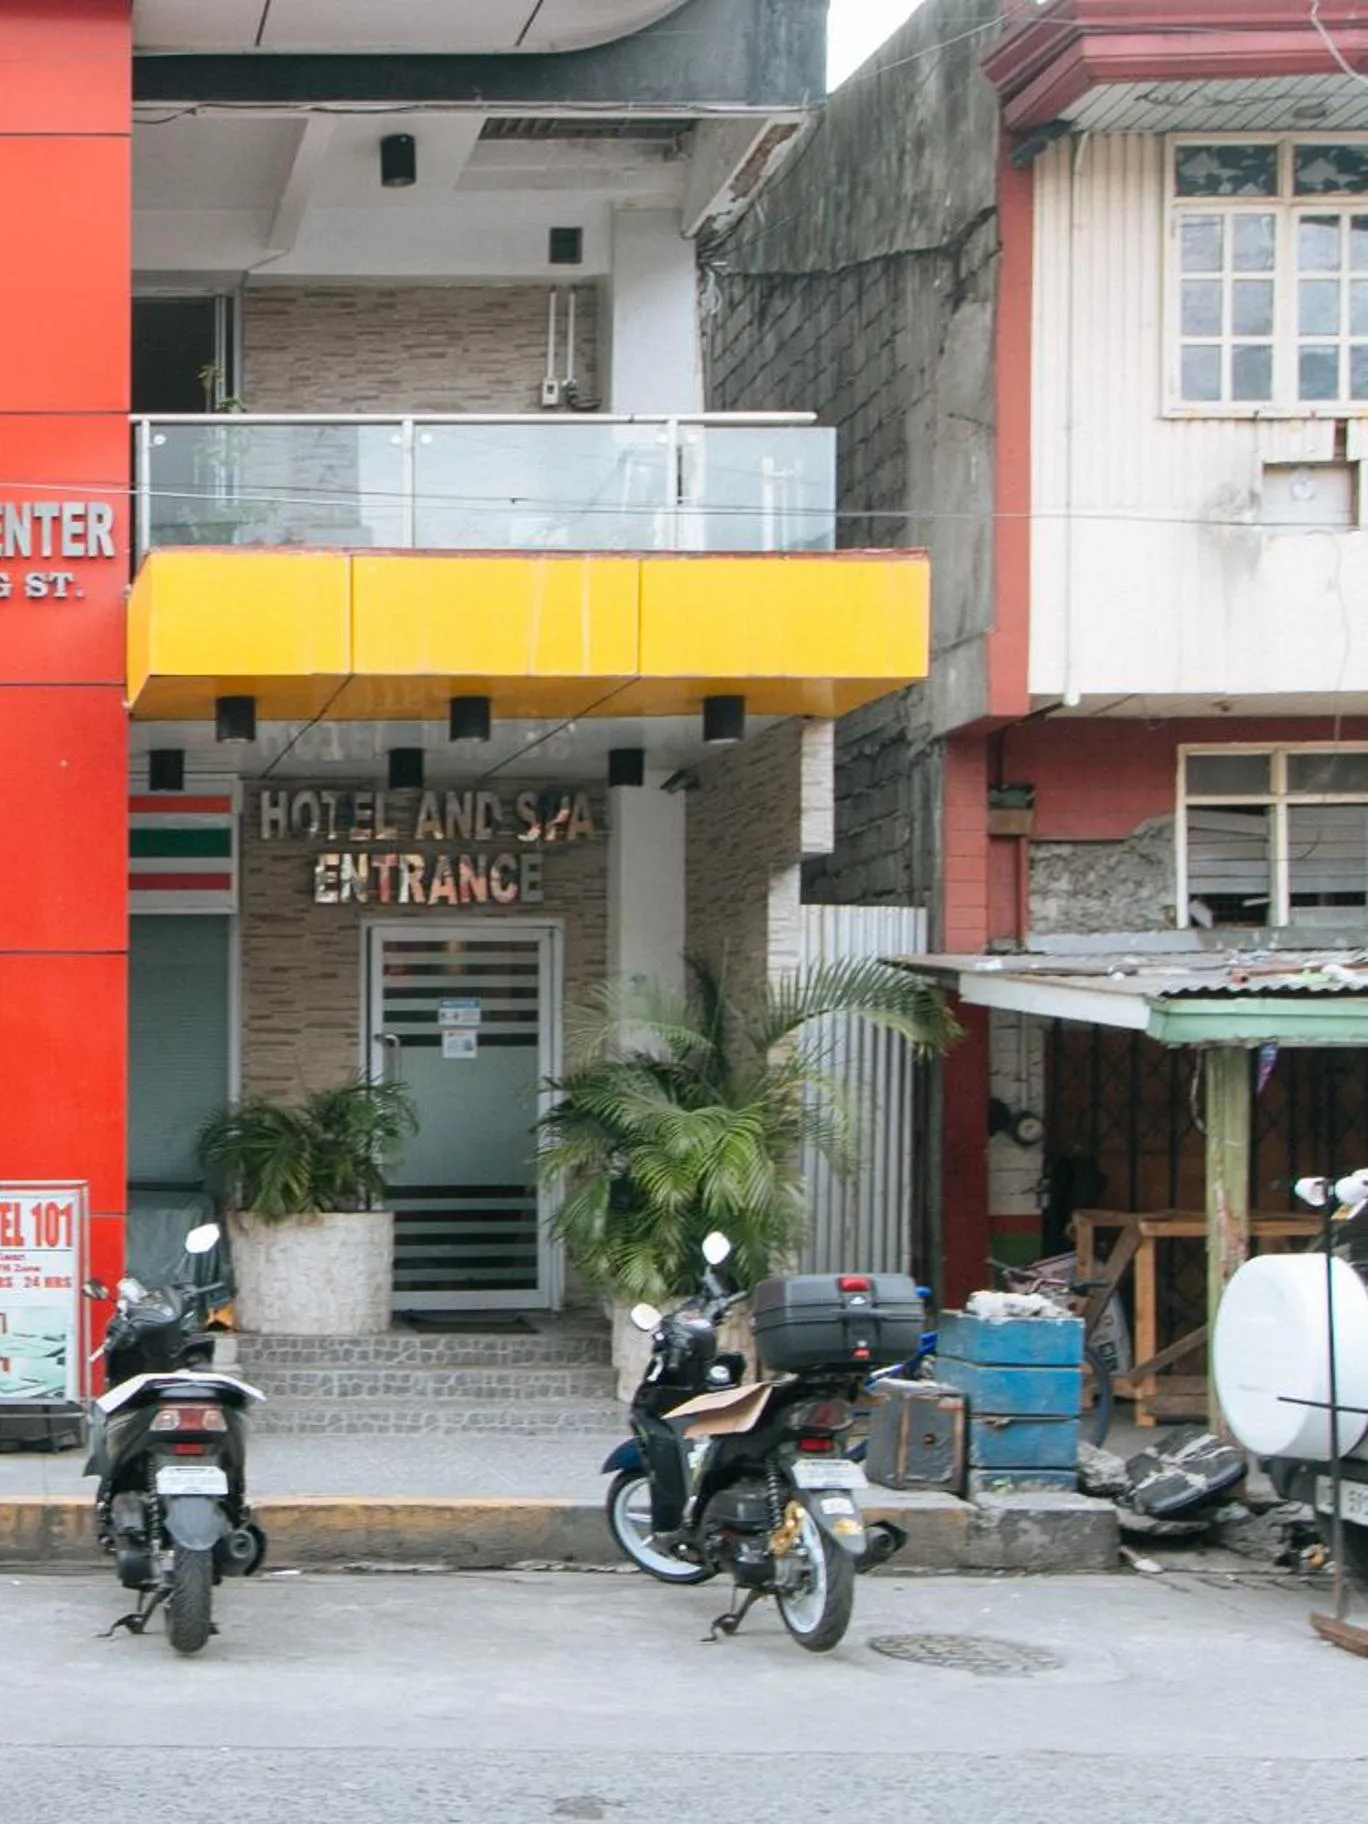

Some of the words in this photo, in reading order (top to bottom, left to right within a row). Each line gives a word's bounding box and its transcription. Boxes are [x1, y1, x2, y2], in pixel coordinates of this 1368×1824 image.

[25, 571, 85, 599] ST.
[259, 790, 400, 841] HOTEL
[415, 790, 503, 841] AND
[516, 790, 595, 842] SPA
[314, 852, 544, 905] ENTRANCE
[31, 1201, 73, 1248] 101
